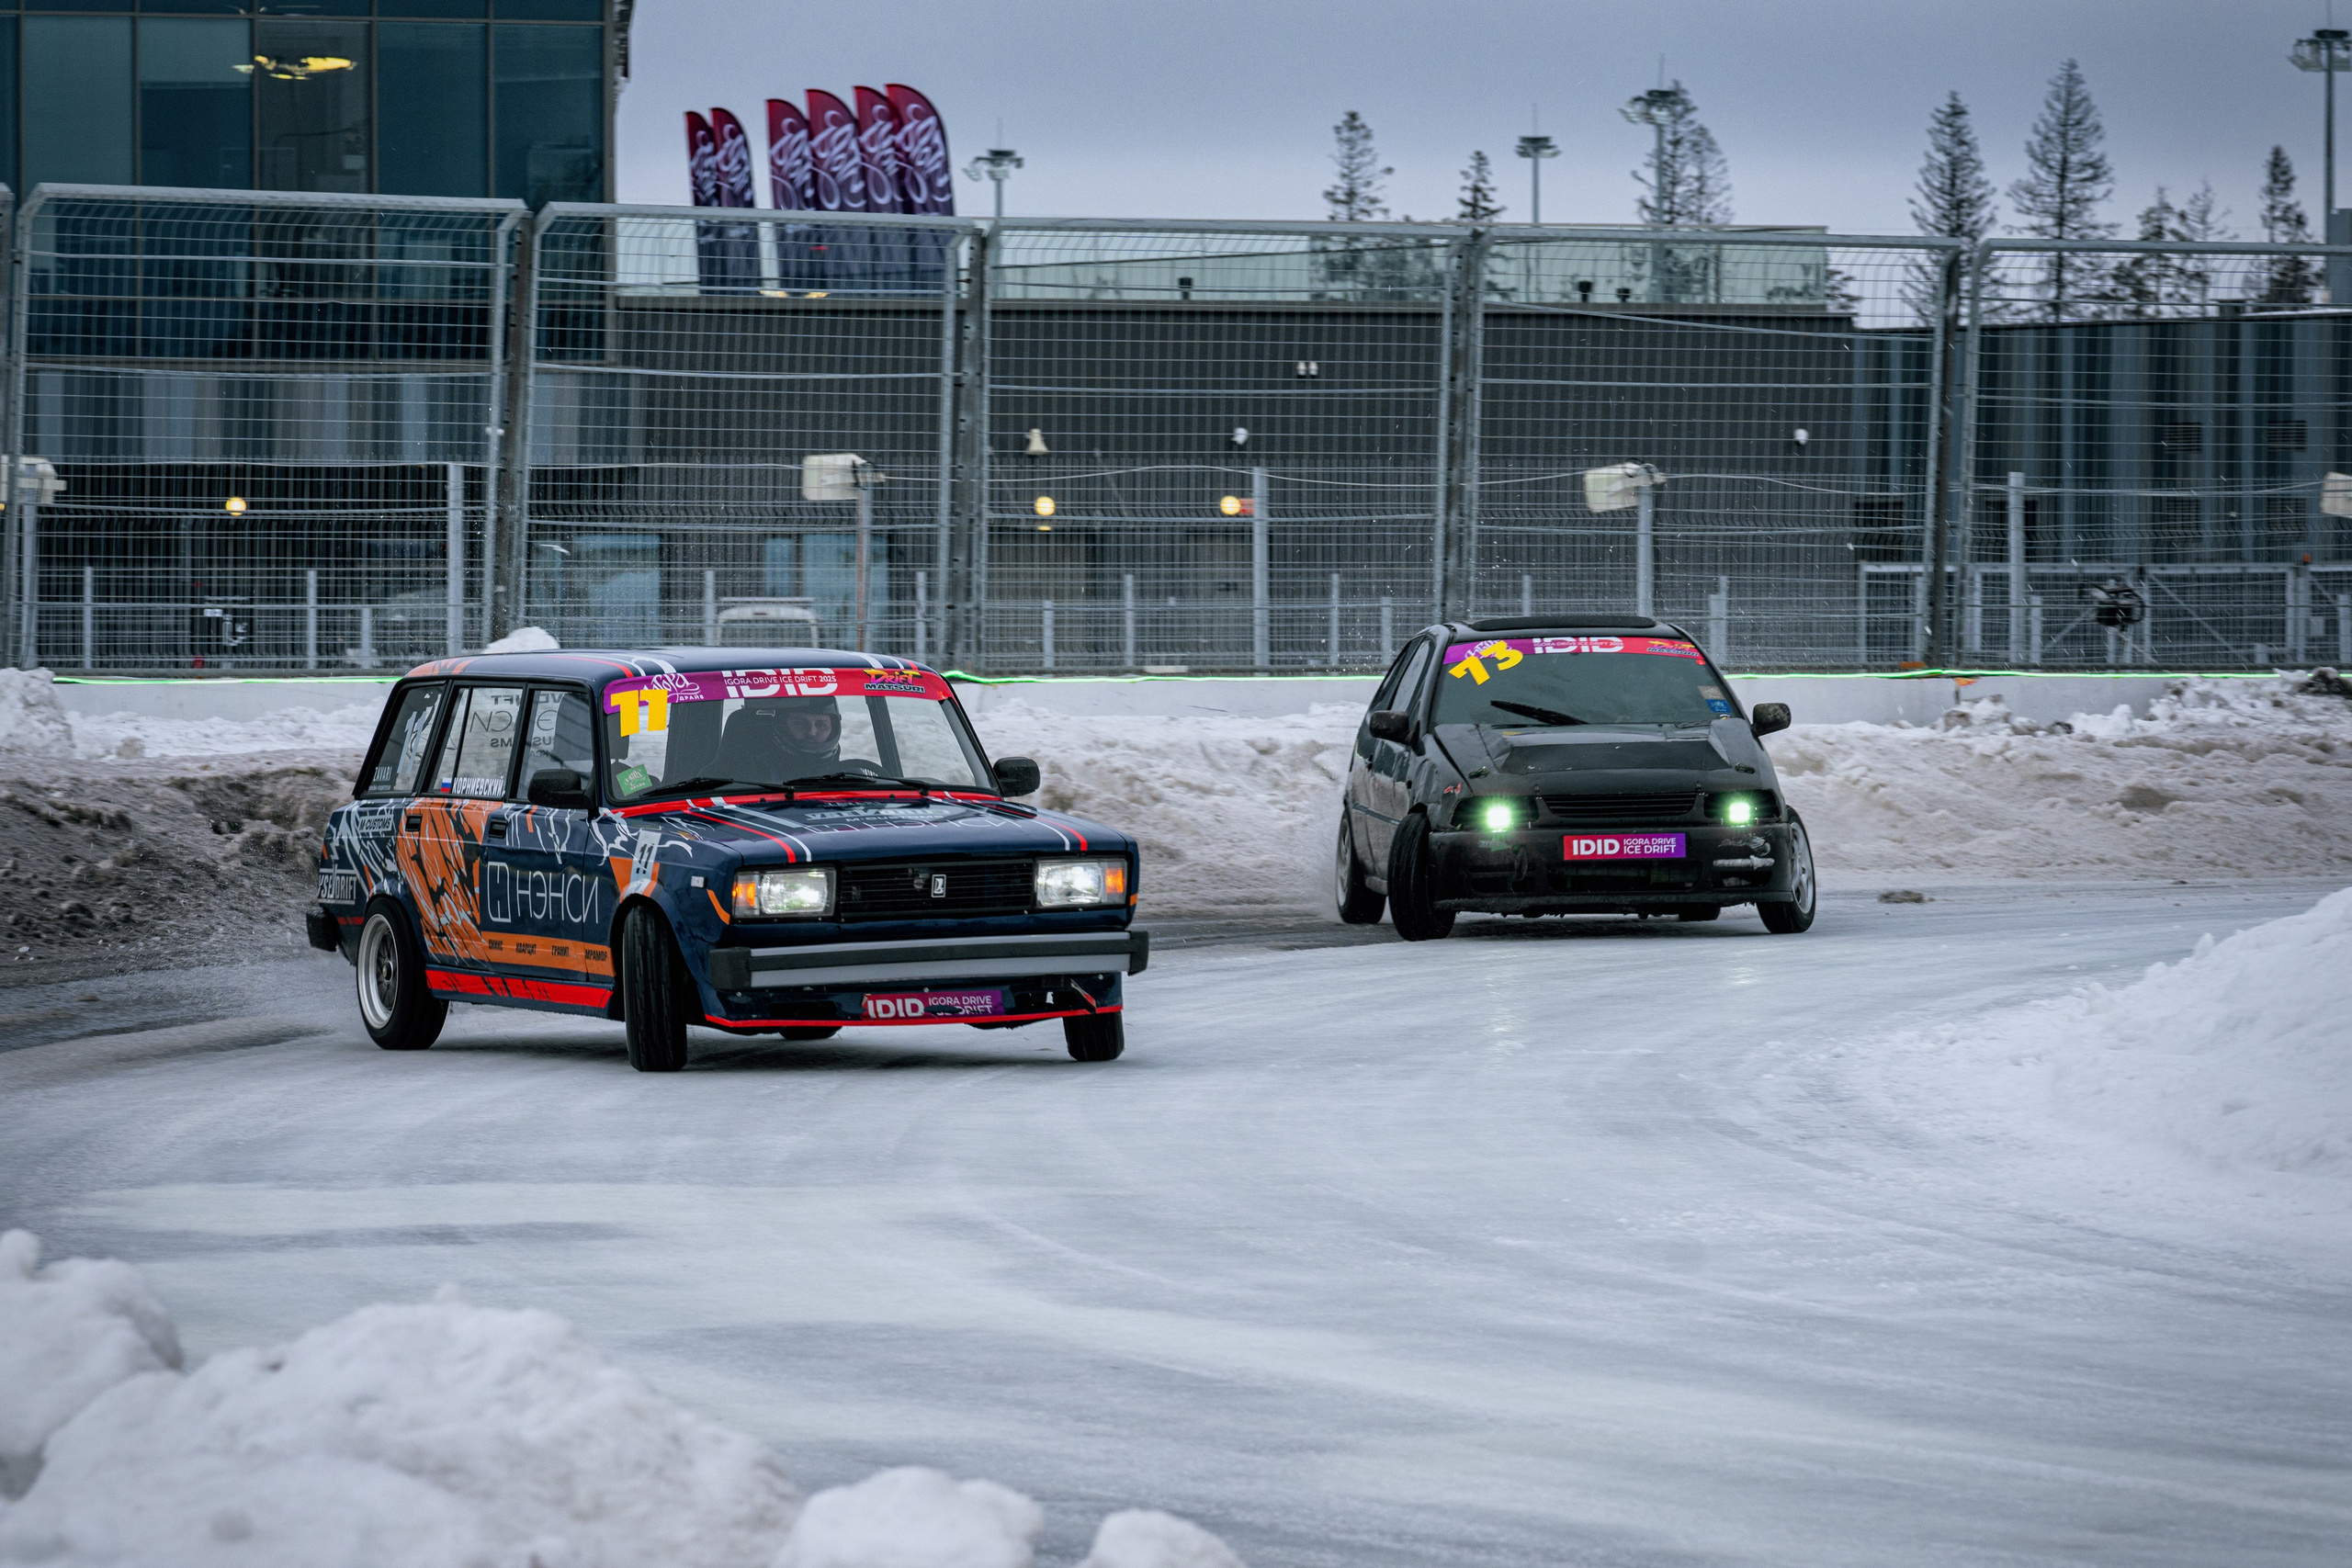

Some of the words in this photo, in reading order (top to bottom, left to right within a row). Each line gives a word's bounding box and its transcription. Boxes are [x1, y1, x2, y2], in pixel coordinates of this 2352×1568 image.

[1532, 637, 1624, 653] IDID
[721, 668, 838, 698] IDID
[724, 676, 752, 686] IGORA
[753, 675, 777, 684] DRIVE
[779, 675, 793, 683] ICE
[795, 675, 817, 683] DRIFT
[864, 682, 925, 694] MATSURI
[610, 689, 668, 738] 11
[1572, 839, 1621, 856] IDID
[1651, 837, 1677, 845] DRIVE
[1623, 845, 1642, 854] ICE
[1644, 844, 1677, 854] DRIFT
[867, 997, 924, 1019] IDID
[928, 996, 960, 1007] IGORA
[962, 995, 992, 1006] DRIVE
